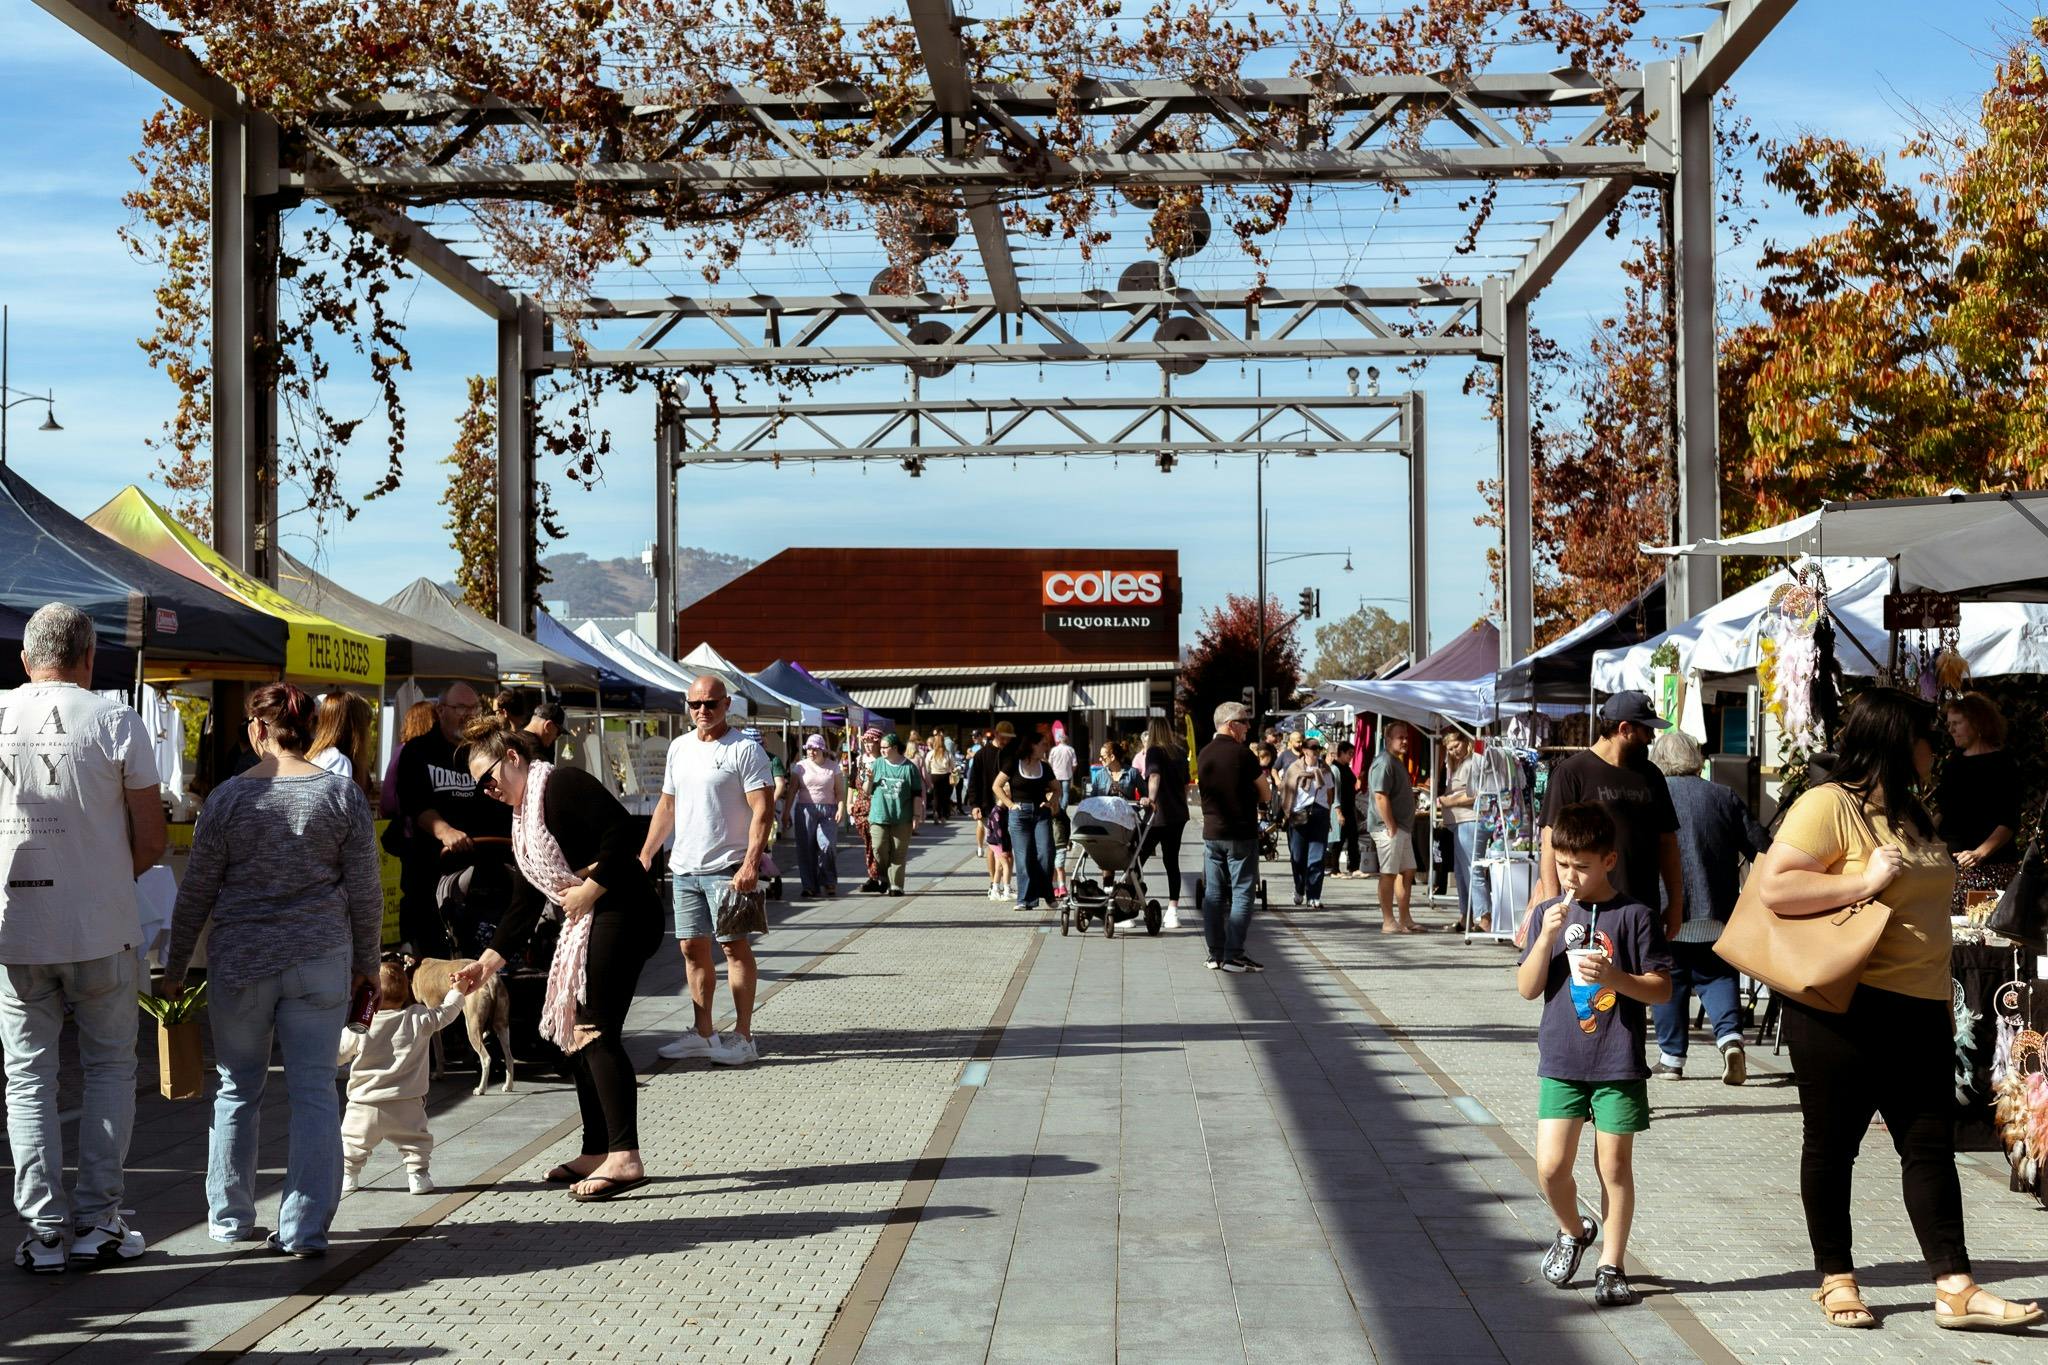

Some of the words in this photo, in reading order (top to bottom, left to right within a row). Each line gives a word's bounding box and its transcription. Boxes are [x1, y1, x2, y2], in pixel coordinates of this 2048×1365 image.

[1046, 570, 1162, 603] coles
[1058, 616, 1151, 630] LIQUORLAND
[307, 632, 333, 670] THE
[334, 640, 341, 673] 3
[342, 637, 371, 677] BEES
[452, 790, 475, 798] LONDO
